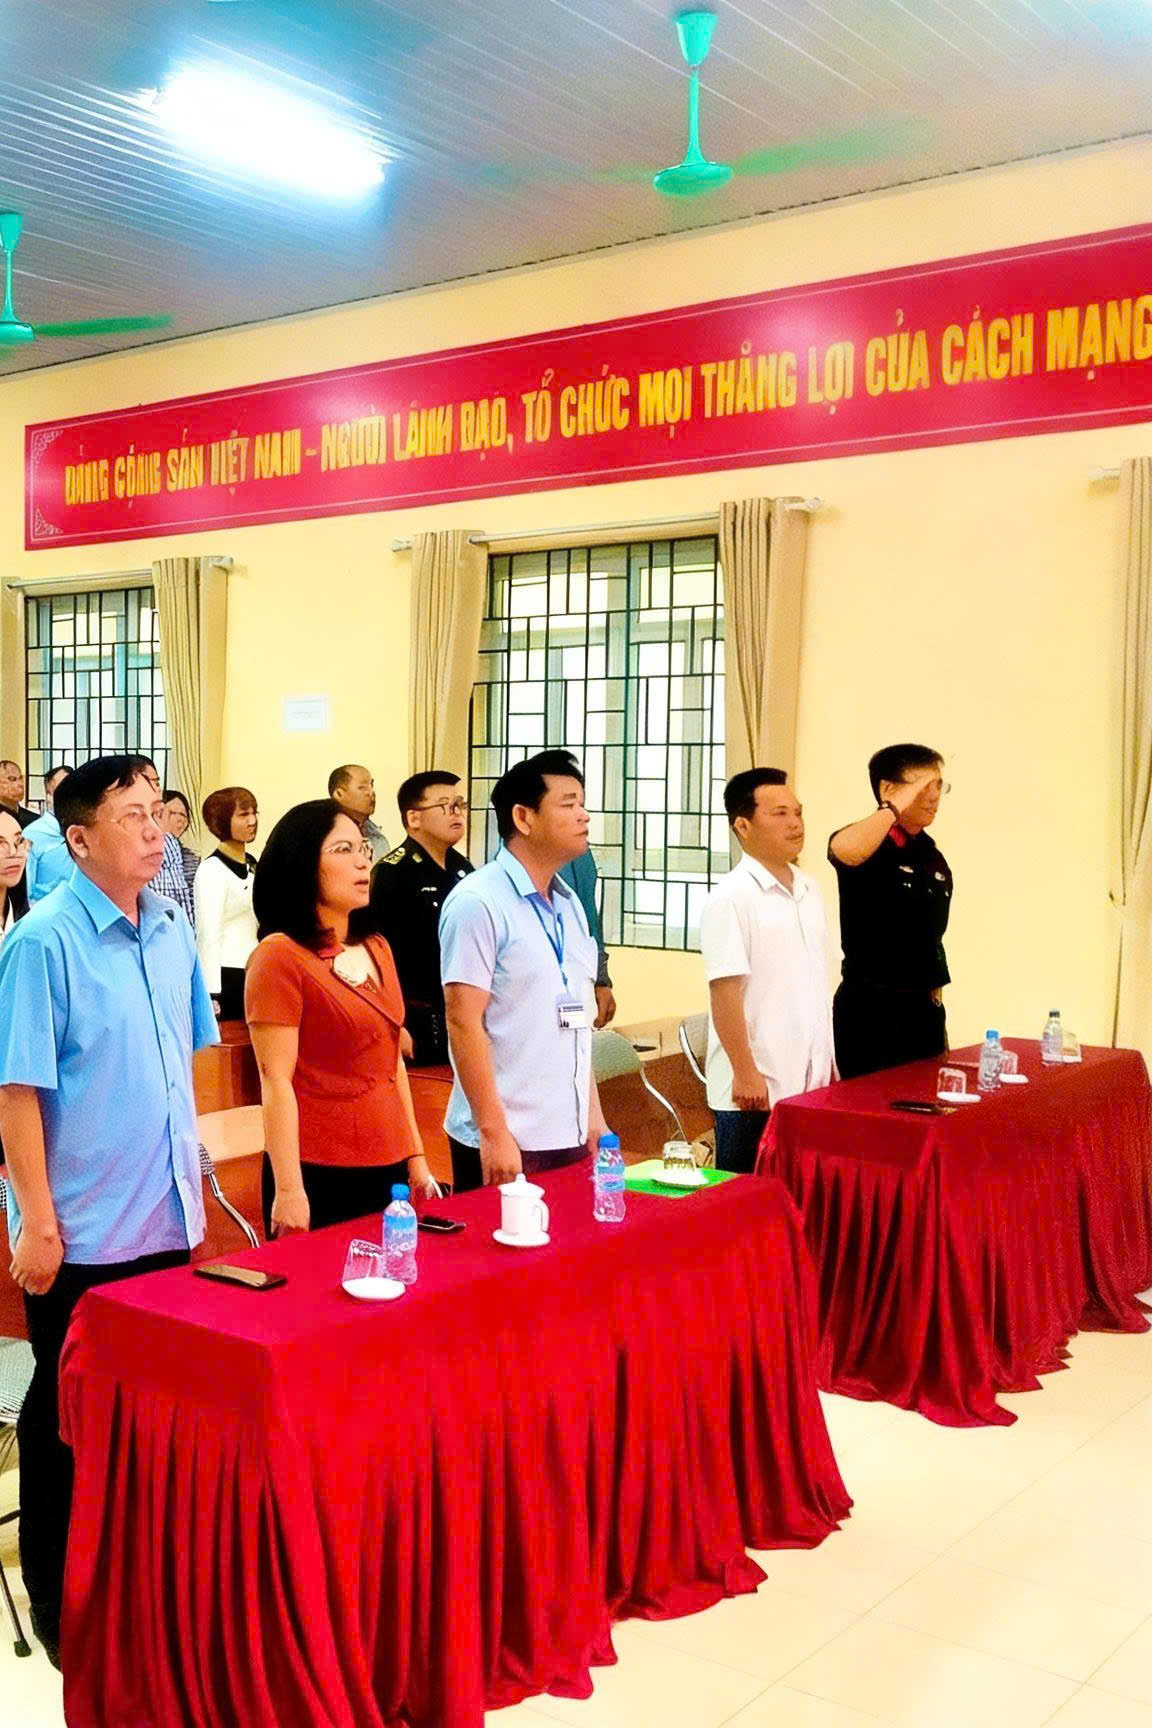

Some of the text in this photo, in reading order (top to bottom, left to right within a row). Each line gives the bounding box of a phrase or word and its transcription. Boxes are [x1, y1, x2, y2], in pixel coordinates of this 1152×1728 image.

[521, 368, 554, 443] TỔ
[559, 364, 630, 438] CHỨC
[639, 366, 693, 439] MỌI
[808, 341, 855, 415] LỢI
[865, 308, 930, 397] CỦA
[1046, 294, 1152, 381] MẠNG
